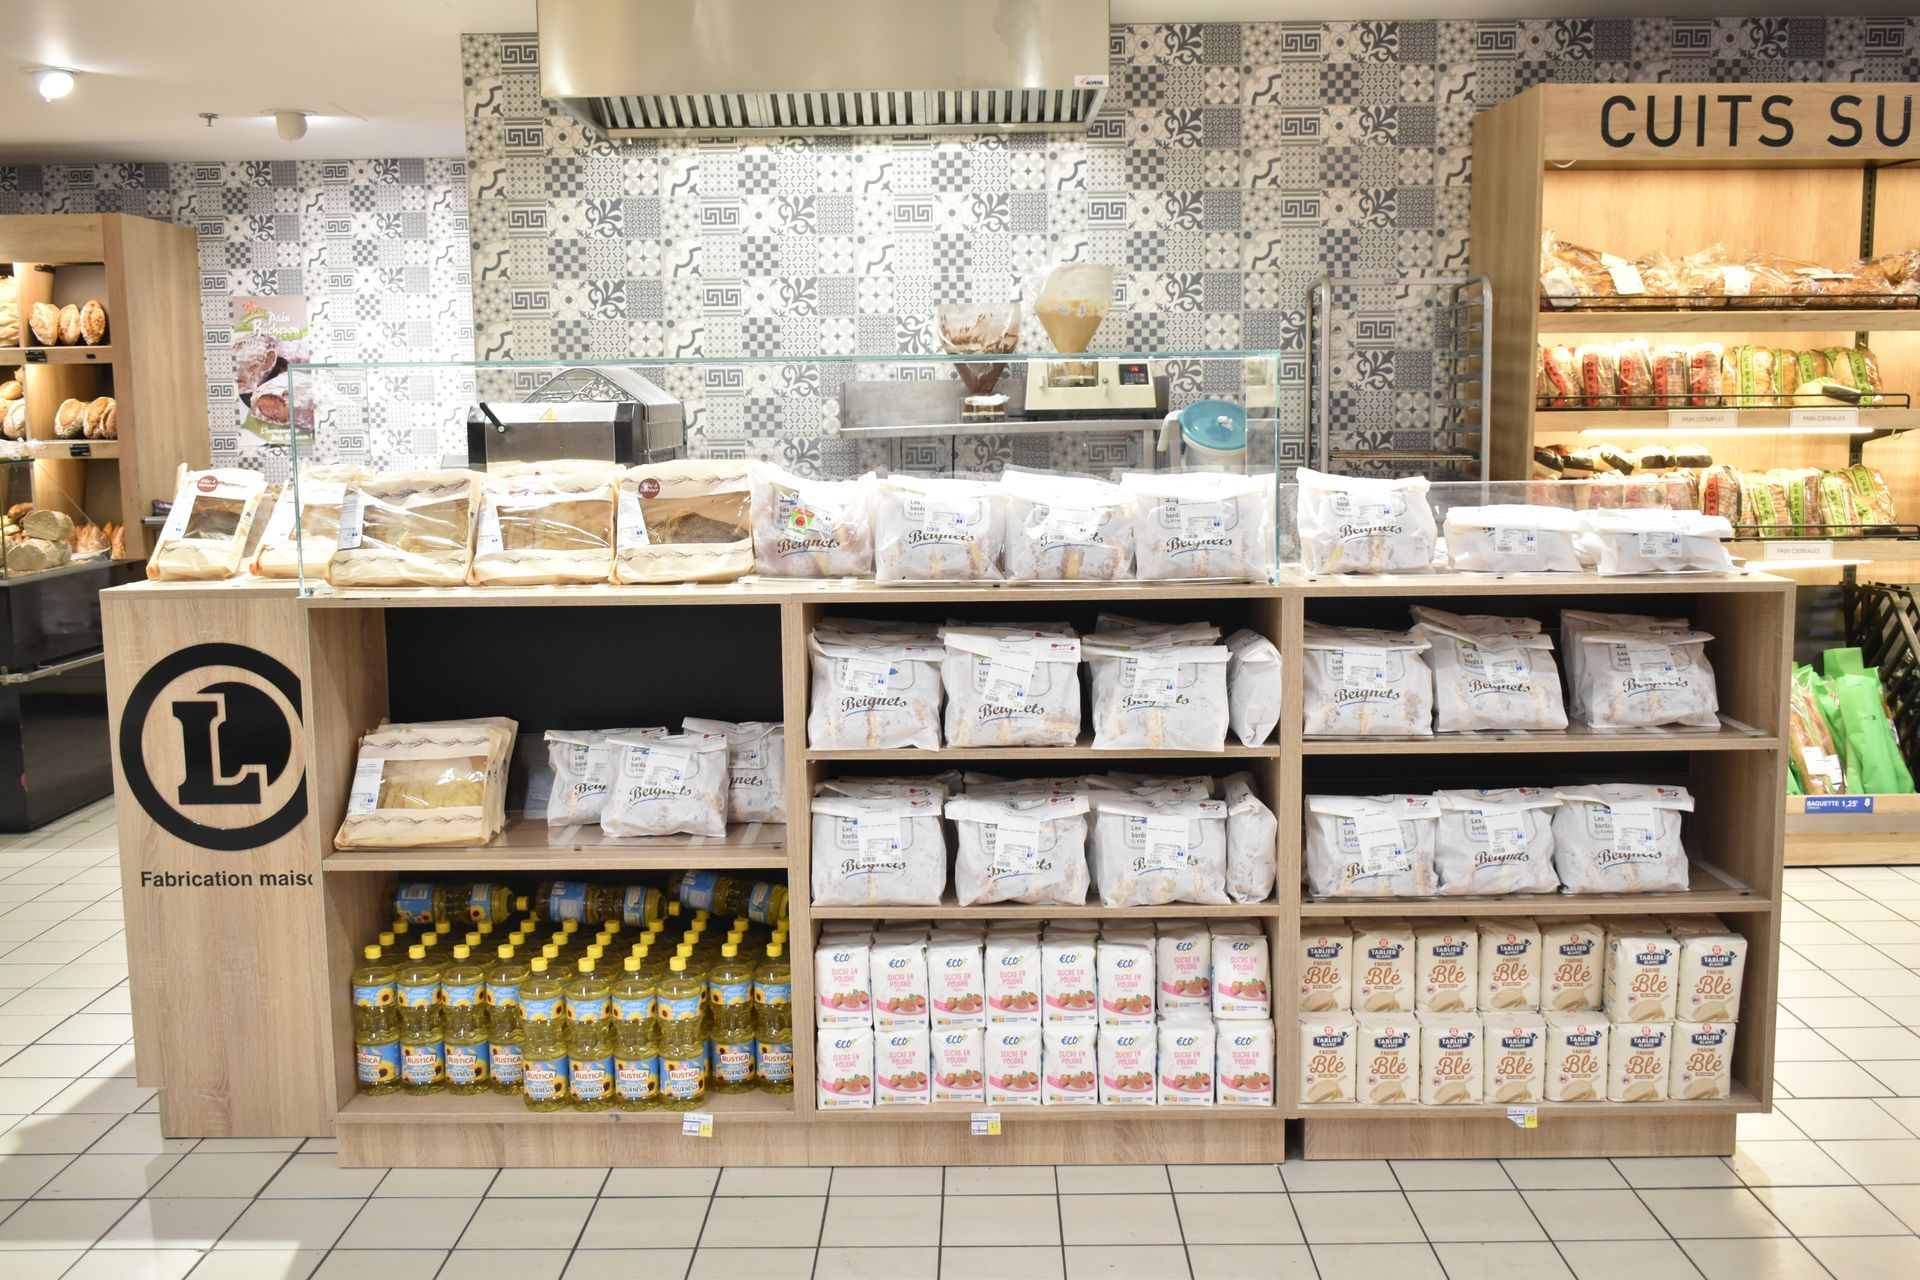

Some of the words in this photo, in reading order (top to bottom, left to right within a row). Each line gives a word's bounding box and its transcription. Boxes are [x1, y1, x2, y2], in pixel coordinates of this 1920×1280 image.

[1600, 95, 1794, 148] CUITS
[1826, 95, 1912, 148] SU
[778, 537, 840, 554] Beignets
[842, 696, 907, 712] Beignets
[1334, 688, 1400, 704] Beignets
[141, 870, 252, 888] Fabrication
[1304, 966, 1340, 984] Blé
[1366, 967, 1401, 985] Blé
[1430, 965, 1464, 983] Blé
[1493, 963, 1528, 981] Blé
[1556, 964, 1592, 982] Blé
[1632, 973, 1668, 992] Blé
[1696, 975, 1732, 995] Blé
[407, 1055, 435, 1064] RUSTICA
[448, 1055, 474, 1064] RUSTICA
[494, 1055, 522, 1064] RUSTICA
[722, 1054, 748, 1062] RUSTICA
[764, 1054, 792, 1062] RUSTICA
[1309, 1055, 1344, 1073] Blé
[1372, 1056, 1408, 1074] Blé
[1436, 1057, 1472, 1075] Blé
[1498, 1056, 1534, 1074] Blé
[1563, 1055, 1599, 1073] Blé
[1626, 1056, 1662, 1074] Blé
[1687, 1053, 1723, 1071] Blé
[672, 1070, 698, 1079] RUSTICA
